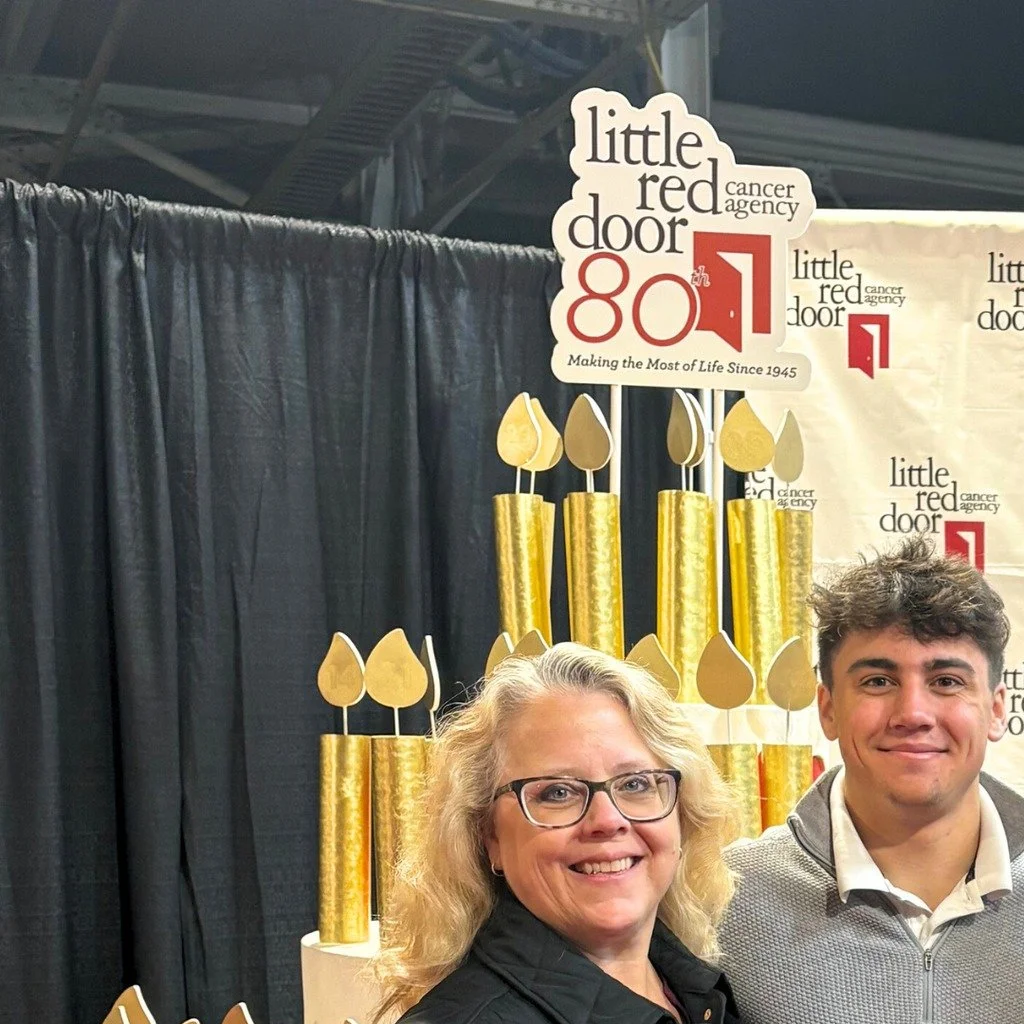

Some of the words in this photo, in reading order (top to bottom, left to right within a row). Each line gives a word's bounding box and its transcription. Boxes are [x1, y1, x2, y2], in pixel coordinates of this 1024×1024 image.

[586, 106, 702, 169] little
[636, 158, 722, 214] red
[726, 180, 795, 198] cancer
[568, 193, 688, 254] door
[725, 199, 800, 222] agency
[793, 249, 854, 280] little
[818, 274, 863, 304] red
[864, 286, 904, 295] cancer
[864, 295, 906, 307] agency
[568, 354, 618, 371] Making
[622, 356, 643, 370] the
[646, 358, 679, 372] Most
[682, 358, 697, 372] of
[698, 360, 724, 373] Life
[727, 362, 763, 375] Since
[766, 365, 797, 378] 1945
[890, 457, 949, 487] little
[915, 481, 959, 512] red
[960, 493, 998, 501] cancer
[960, 502, 1000, 514] agency
[880, 503, 942, 533] door
